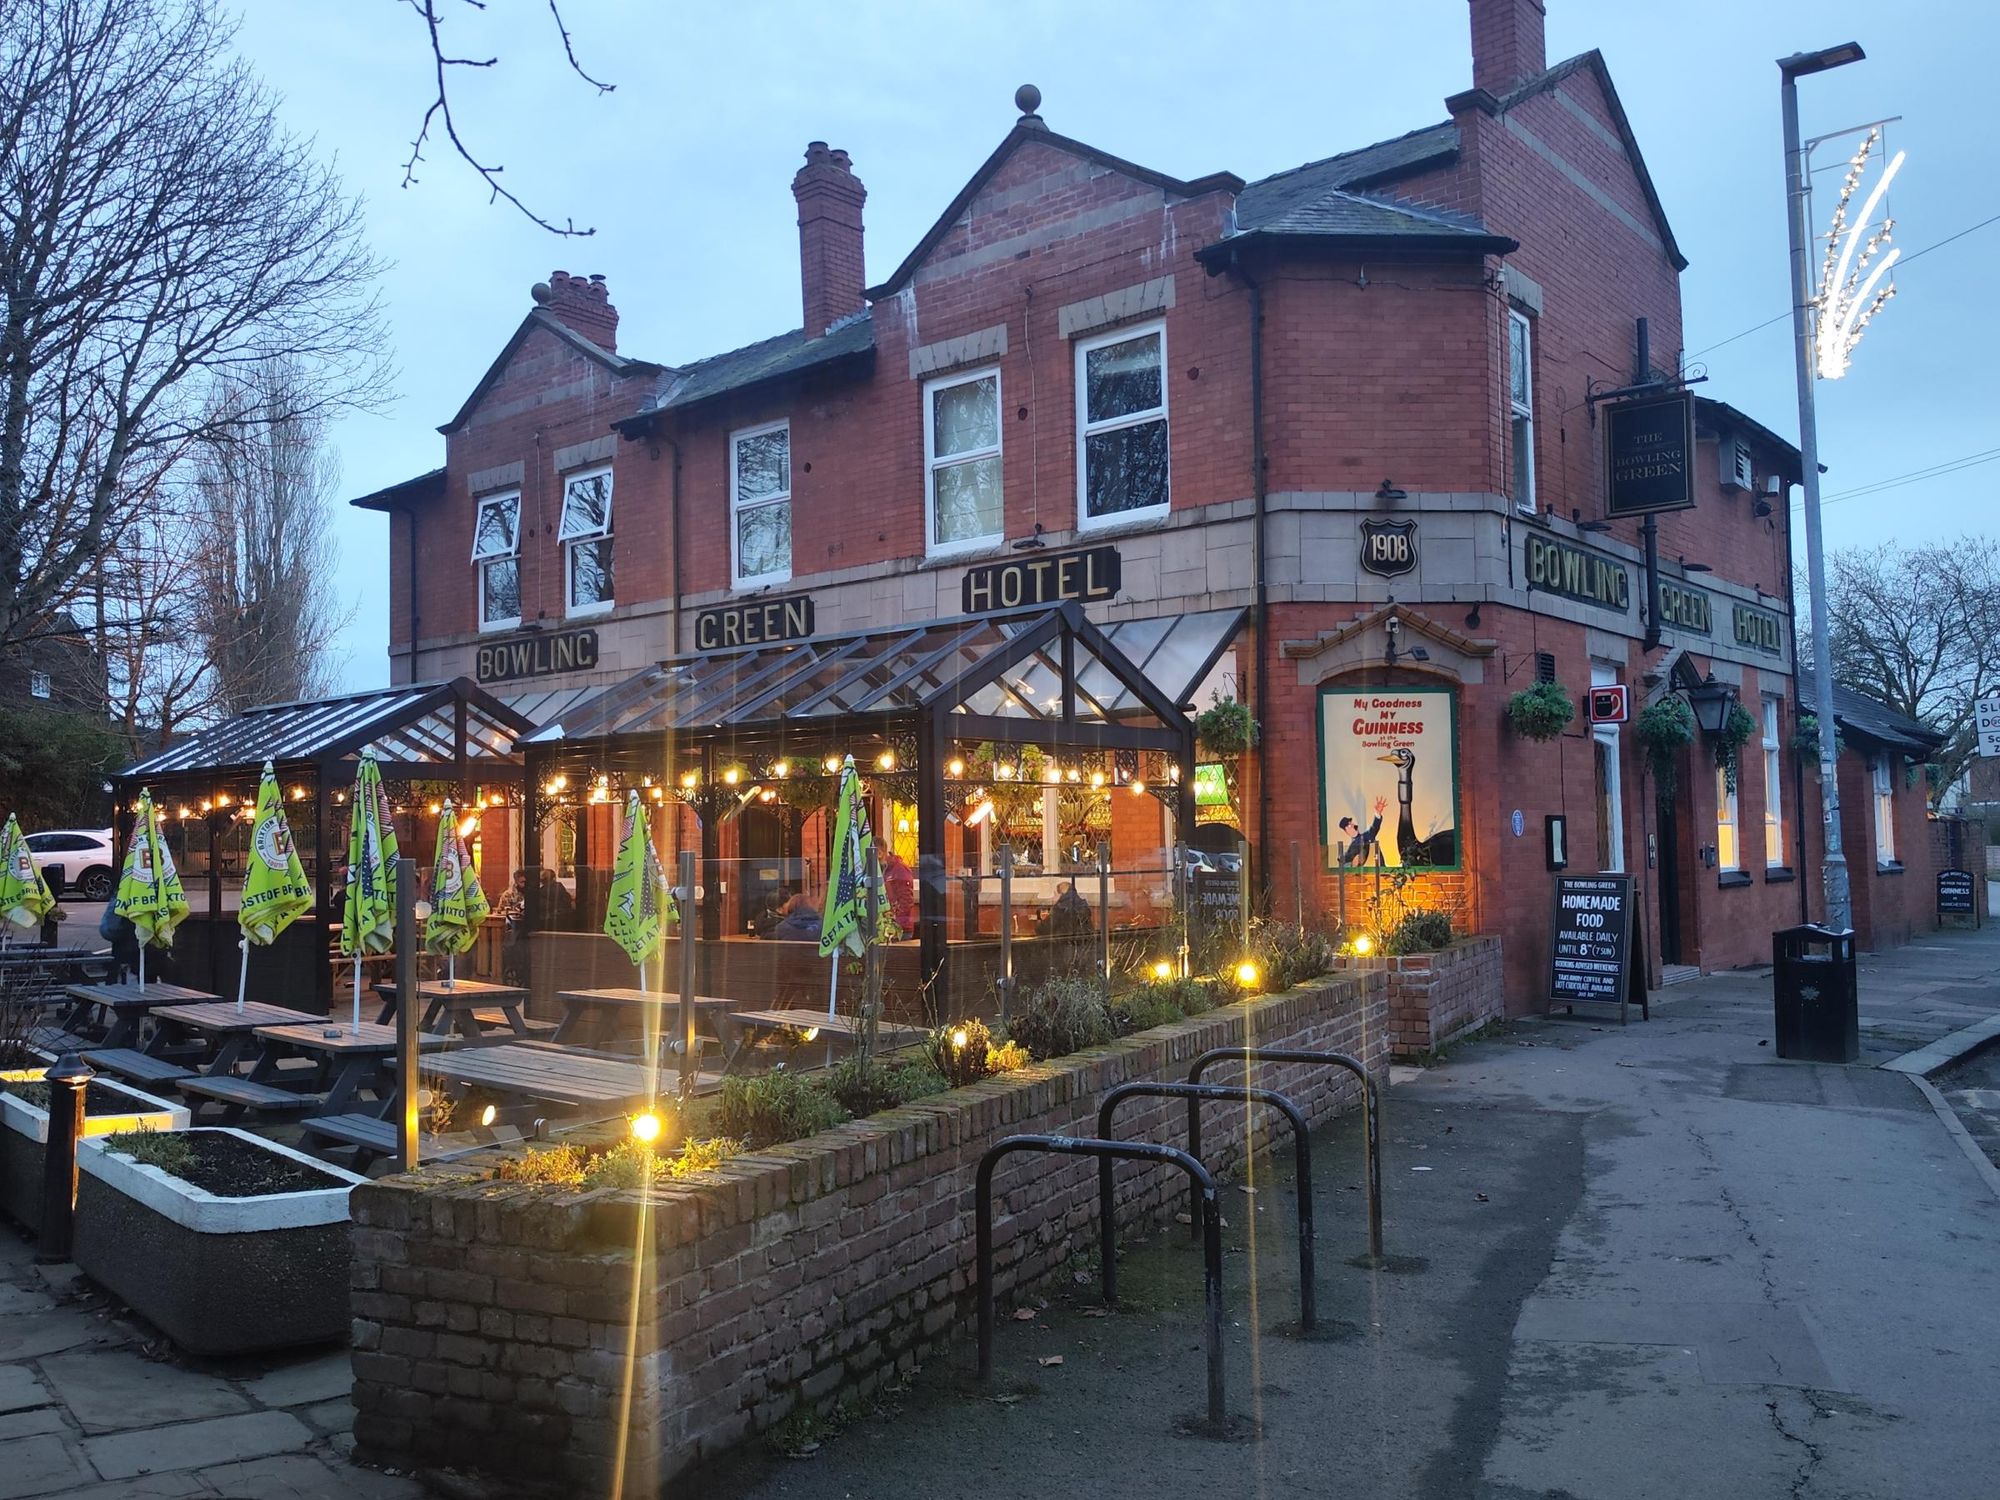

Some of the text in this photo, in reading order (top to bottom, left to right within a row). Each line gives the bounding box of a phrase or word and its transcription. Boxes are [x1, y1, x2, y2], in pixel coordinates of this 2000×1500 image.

[1633, 432, 1663, 444] THE
[1615, 449, 1681, 467] BOWLING
[1615, 462, 1681, 481] GREEN
[1370, 534, 1408, 562] 1908
[1530, 539, 1780, 650] BOWLING GREEN HOTEL
[480, 553, 1110, 680] BOWLING GREEN HOTEL
[1353, 698, 1422, 711] My Goodness
[1980, 703, 2000, 713] SL
[1380, 711, 1396, 719] MY
[1352, 718, 1424, 735] GUINNESS
[1362, 740, 1391, 749] Bowling
[1574, 881, 1597, 889] BOWLING
[1562, 895, 1621, 911] HOMEMADE
[1576, 913, 1604, 927] FOOD
[1559, 930, 1618, 943] AVAILABLE DAILY
[1558, 944, 1578, 955] UNTIL
